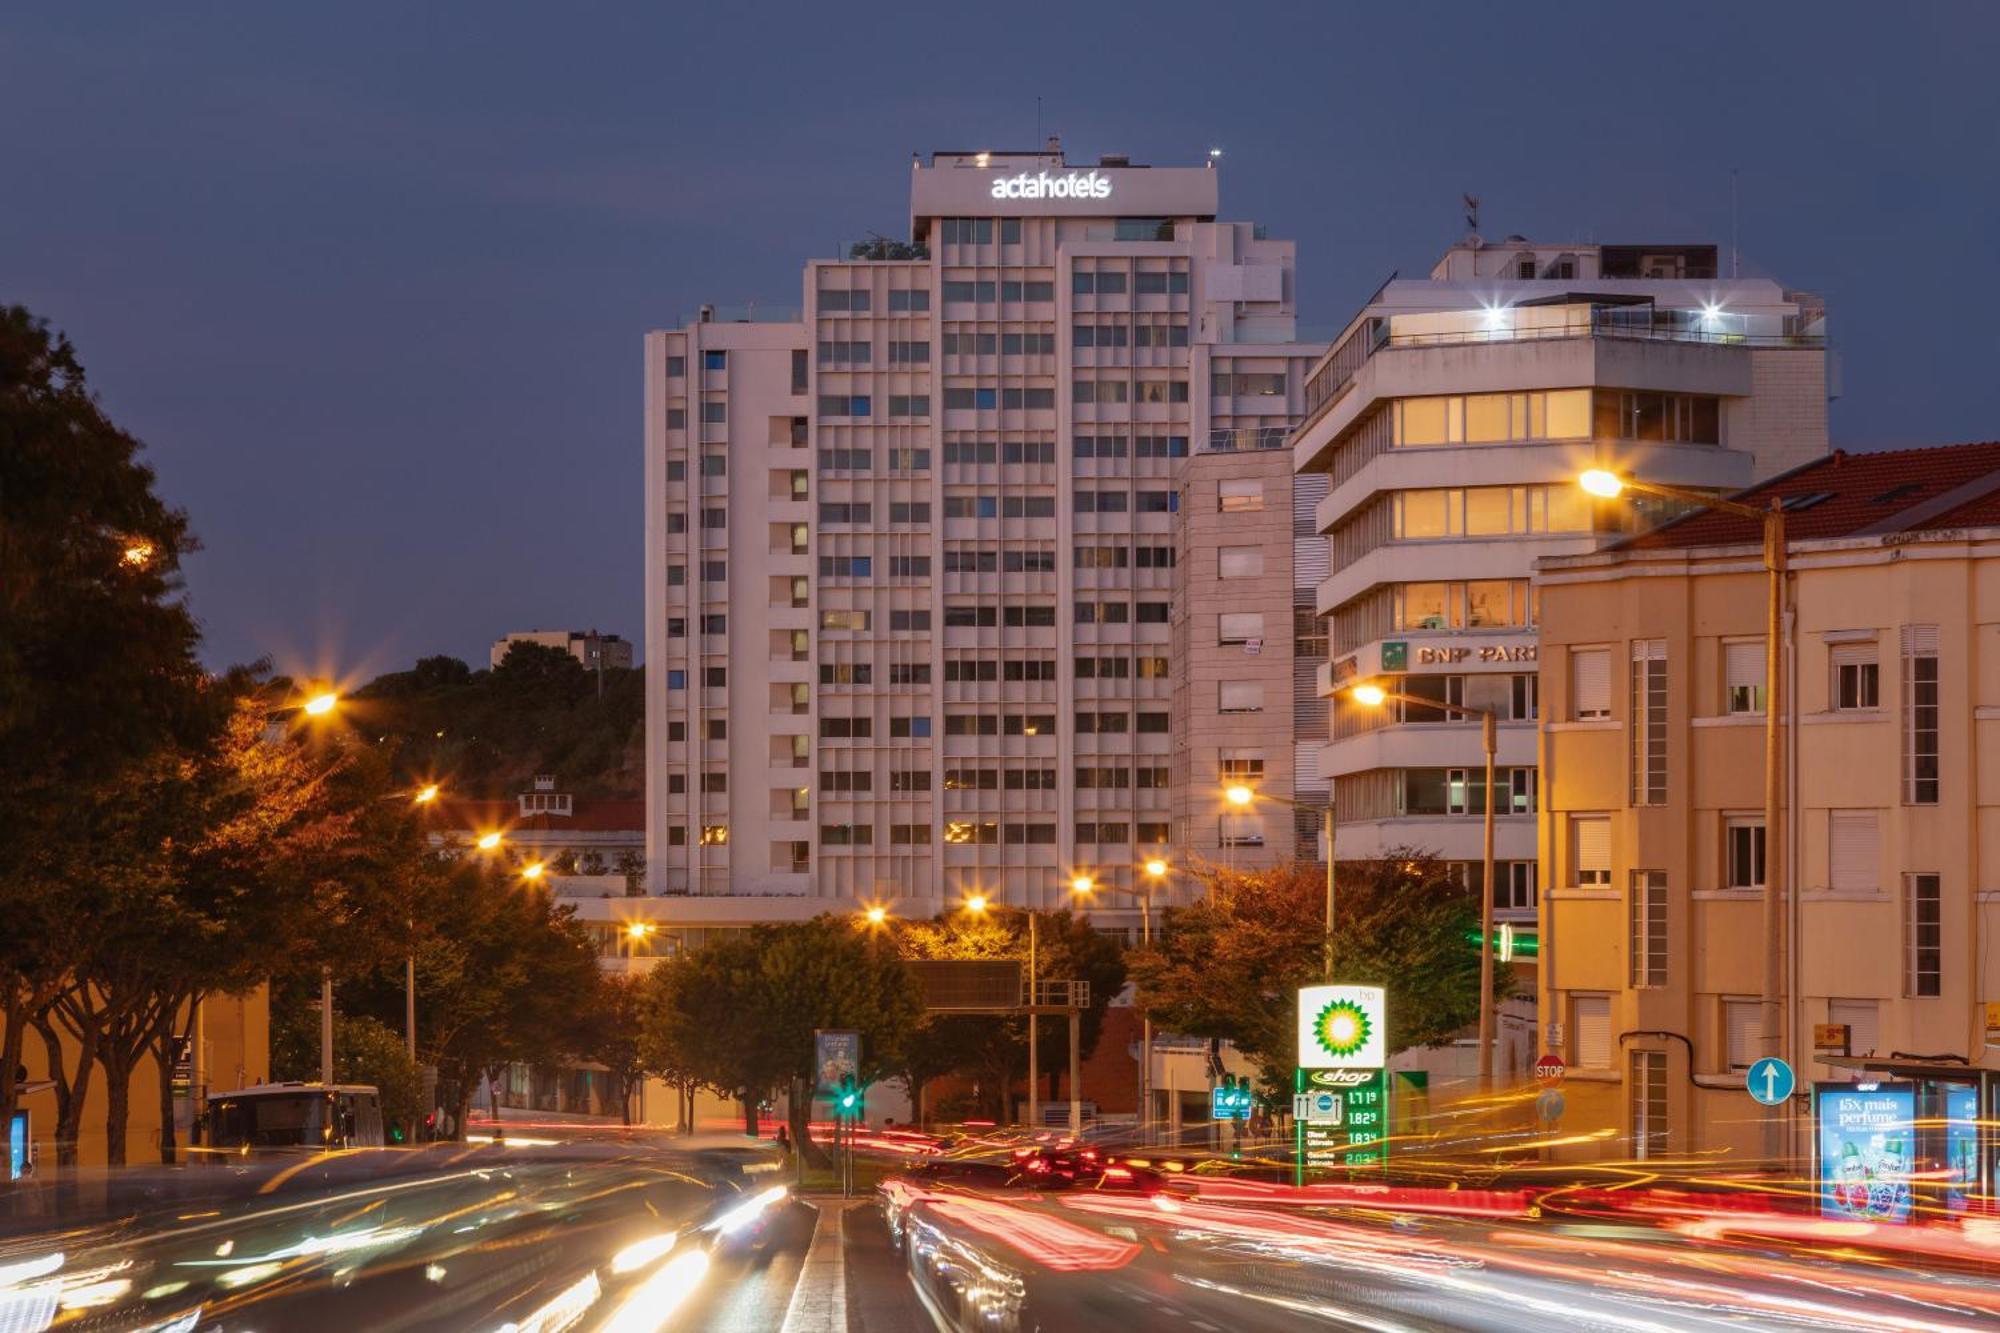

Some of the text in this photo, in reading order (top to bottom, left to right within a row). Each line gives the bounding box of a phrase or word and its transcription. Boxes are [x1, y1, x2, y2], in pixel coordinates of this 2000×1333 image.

[991, 171, 1112, 198] actahotels
[1416, 647, 1471, 664] BNP
[1323, 1069, 1374, 1086] shop
[1536, 1066, 1564, 1078] STOP
[1864, 1098, 1897, 1111] mais
[1839, 1111, 1897, 1126] perfume
